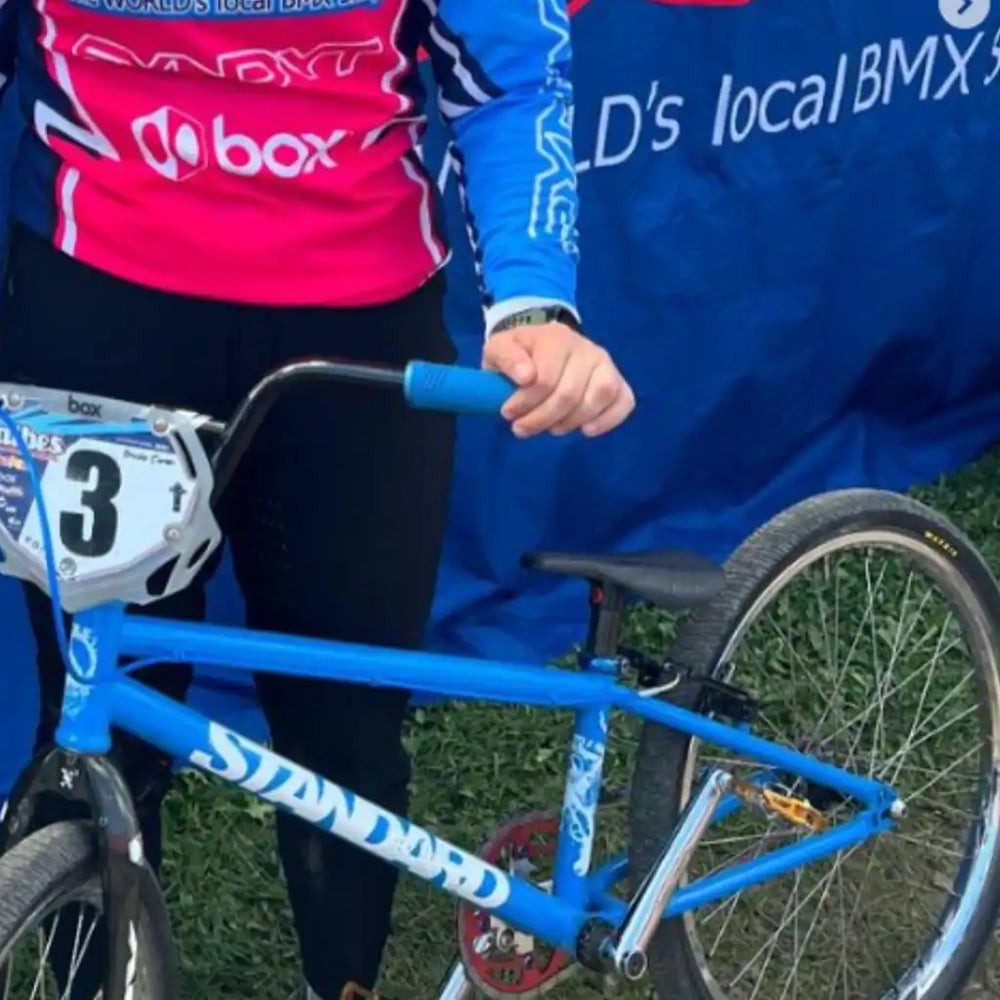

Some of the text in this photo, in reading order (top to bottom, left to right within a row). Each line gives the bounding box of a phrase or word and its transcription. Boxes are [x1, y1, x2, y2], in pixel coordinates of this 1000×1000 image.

[712, 53, 848, 146] local
[853, 31, 984, 114] BMX
[212, 113, 347, 179] box
[67, 395, 102, 418] box
[59, 449, 122, 558] 3
[188, 720, 512, 909] STANDARD
